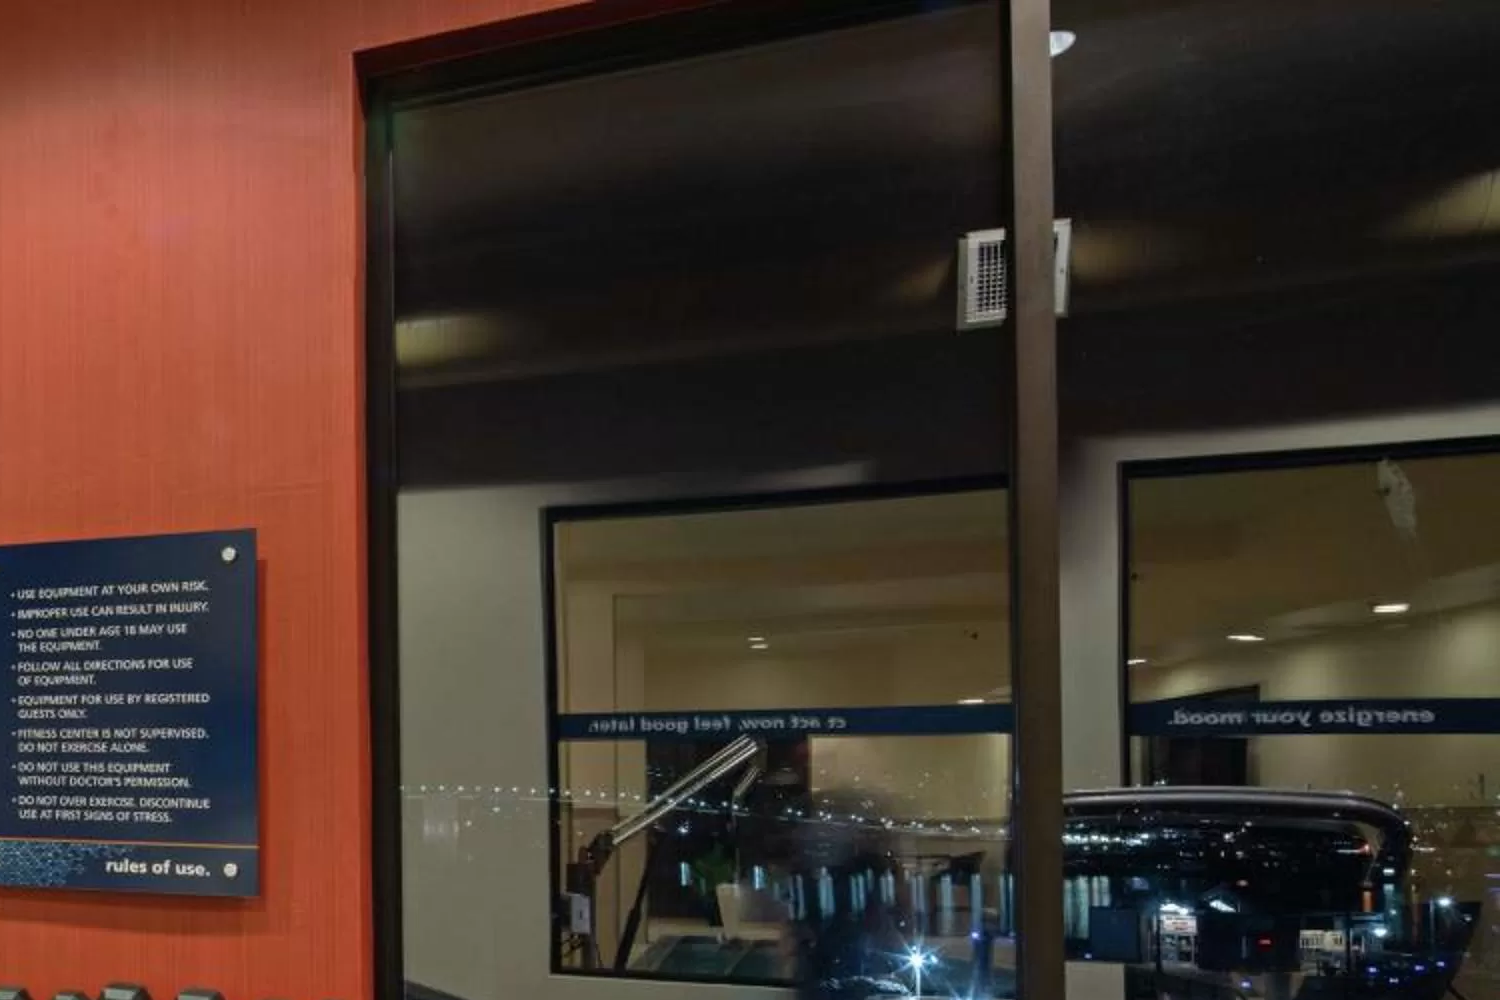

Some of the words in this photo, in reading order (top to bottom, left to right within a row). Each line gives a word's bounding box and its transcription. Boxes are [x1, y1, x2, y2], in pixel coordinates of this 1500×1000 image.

[17, 589, 36, 600] USE
[39, 585, 99, 599] EQUIPMENT
[101, 585, 115, 596] AT
[117, 583, 148, 595] YOUR
[151, 581, 179, 593] OWN
[181, 580, 209, 592] RISK.
[17, 607, 68, 619] IMPROPER
[70, 606, 89, 617] USE
[90, 605, 114, 617] CAN
[115, 603, 153, 615] RESULT
[155, 602, 167, 613] IN
[169, 601, 209, 613] INJURY.
[17, 628, 34, 639] NO
[36, 628, 58, 638] ONE
[61, 626, 96, 638] UNDER
[99, 625, 120, 636] AGE
[138, 623, 163, 635] MAY
[167, 623, 188, 634] USE
[18, 641, 37, 653] THE
[39, 639, 102, 652] EQUIPMENT.
[17, 660, 61, 672] FOLLOW
[63, 660, 81, 671] ALL
[83, 659, 145, 670] DIRECTIONS
[148, 658, 170, 669] FOR
[172, 658, 194, 669] USE
[17, 675, 32, 686] OF
[34, 674, 97, 686] EQUIPMENT.
[17, 695, 78, 706] EQUIPMENT
[81, 694, 101, 705] FOR
[104, 694, 124, 705] USE
[127, 693, 142, 704] BY
[144, 692, 211, 704] REGISTERED
[17, 708, 56, 719] GUESTS
[17, 728, 57, 739] FITNESS
[59, 728, 100, 739] CENTER
[101, 728, 111, 739] IS
[113, 728, 137, 739] NOT
[140, 727, 209, 739] SUPERVISED.
[17, 742, 35, 753] DO
[37, 742, 57, 753] NOT
[61, 742, 108, 753] EXERCISE
[110, 742, 149, 753] ALONE.
[17, 761, 34, 772] DO
[37, 761, 57, 772] NOT
[61, 762, 80, 773] USE
[83, 762, 105, 773] THIS
[107, 762, 171, 773] EQUIPMENT
[18, 776, 66, 787] WITHOUT
[123, 777, 192, 788] PERMISSION.
[17, 795, 35, 806] DO
[37, 795, 57, 807] NOT
[59, 796, 87, 807] OVER
[139, 797, 211, 809] DISCONTINUE
[18, 809, 37, 820] USE
[40, 810, 52, 820] AT
[55, 810, 81, 821] FIRST
[83, 810, 114, 821] SIGNS
[116, 811, 130, 822] OF
[133, 811, 173, 823] STRESS.
[105, 858, 148, 874] rules
[151, 859, 172, 875] of
[175, 863, 211, 877] use.
